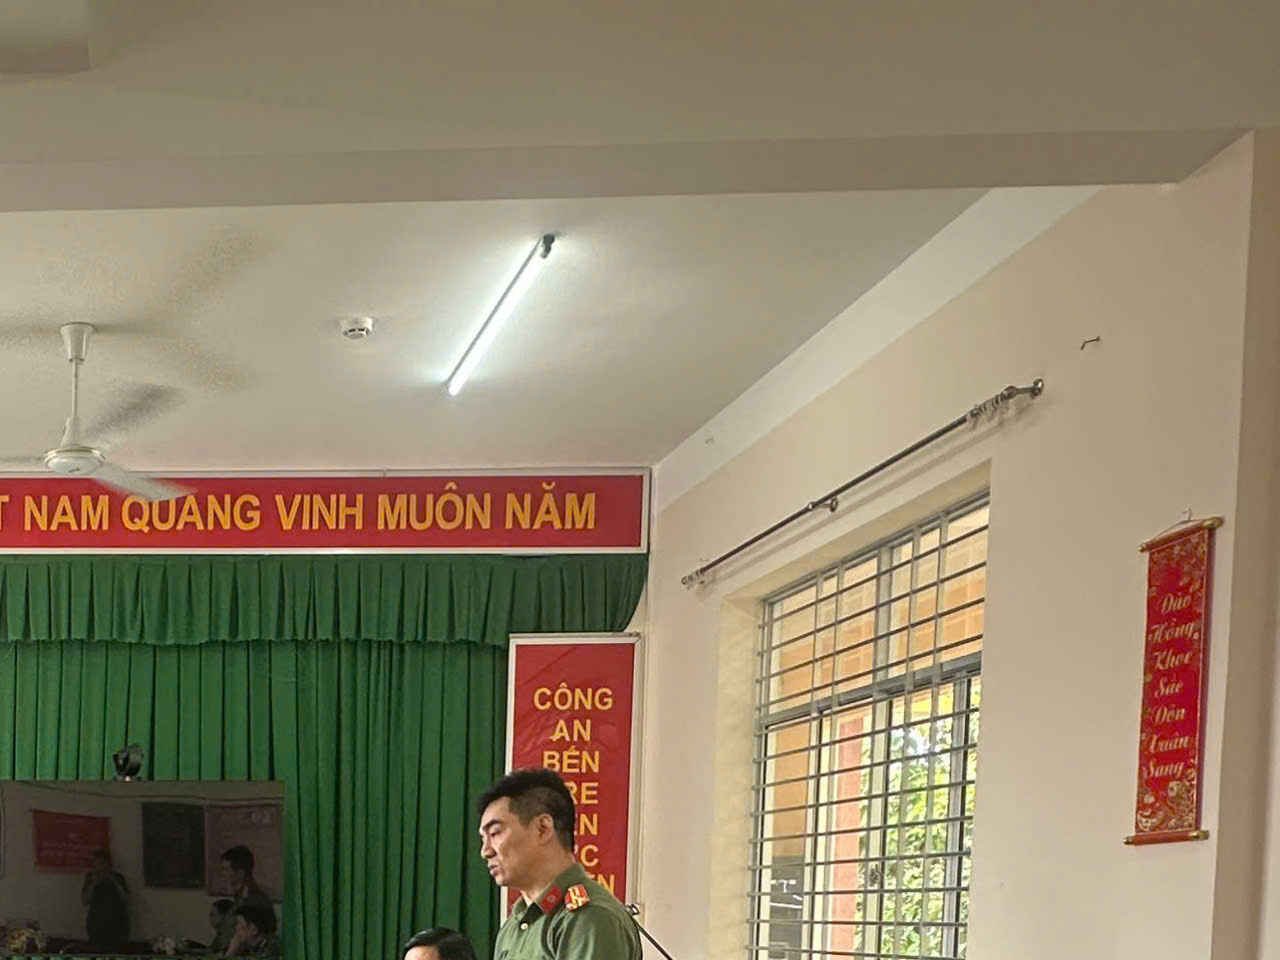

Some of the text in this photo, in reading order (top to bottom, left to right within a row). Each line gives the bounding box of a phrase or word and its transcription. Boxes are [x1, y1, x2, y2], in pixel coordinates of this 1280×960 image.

[23, 494, 110, 531] NAM
[120, 493, 261, 533] QUANG
[274, 493, 364, 531] VINH
[376, 482, 492, 531] MUÔN
[504, 481, 596, 531] NĂM
[533, 682, 613, 711] CÔNG
[549, 719, 591, 742] AN
[543, 745, 600, 773] BẾN
[564, 781, 599, 805] RE
